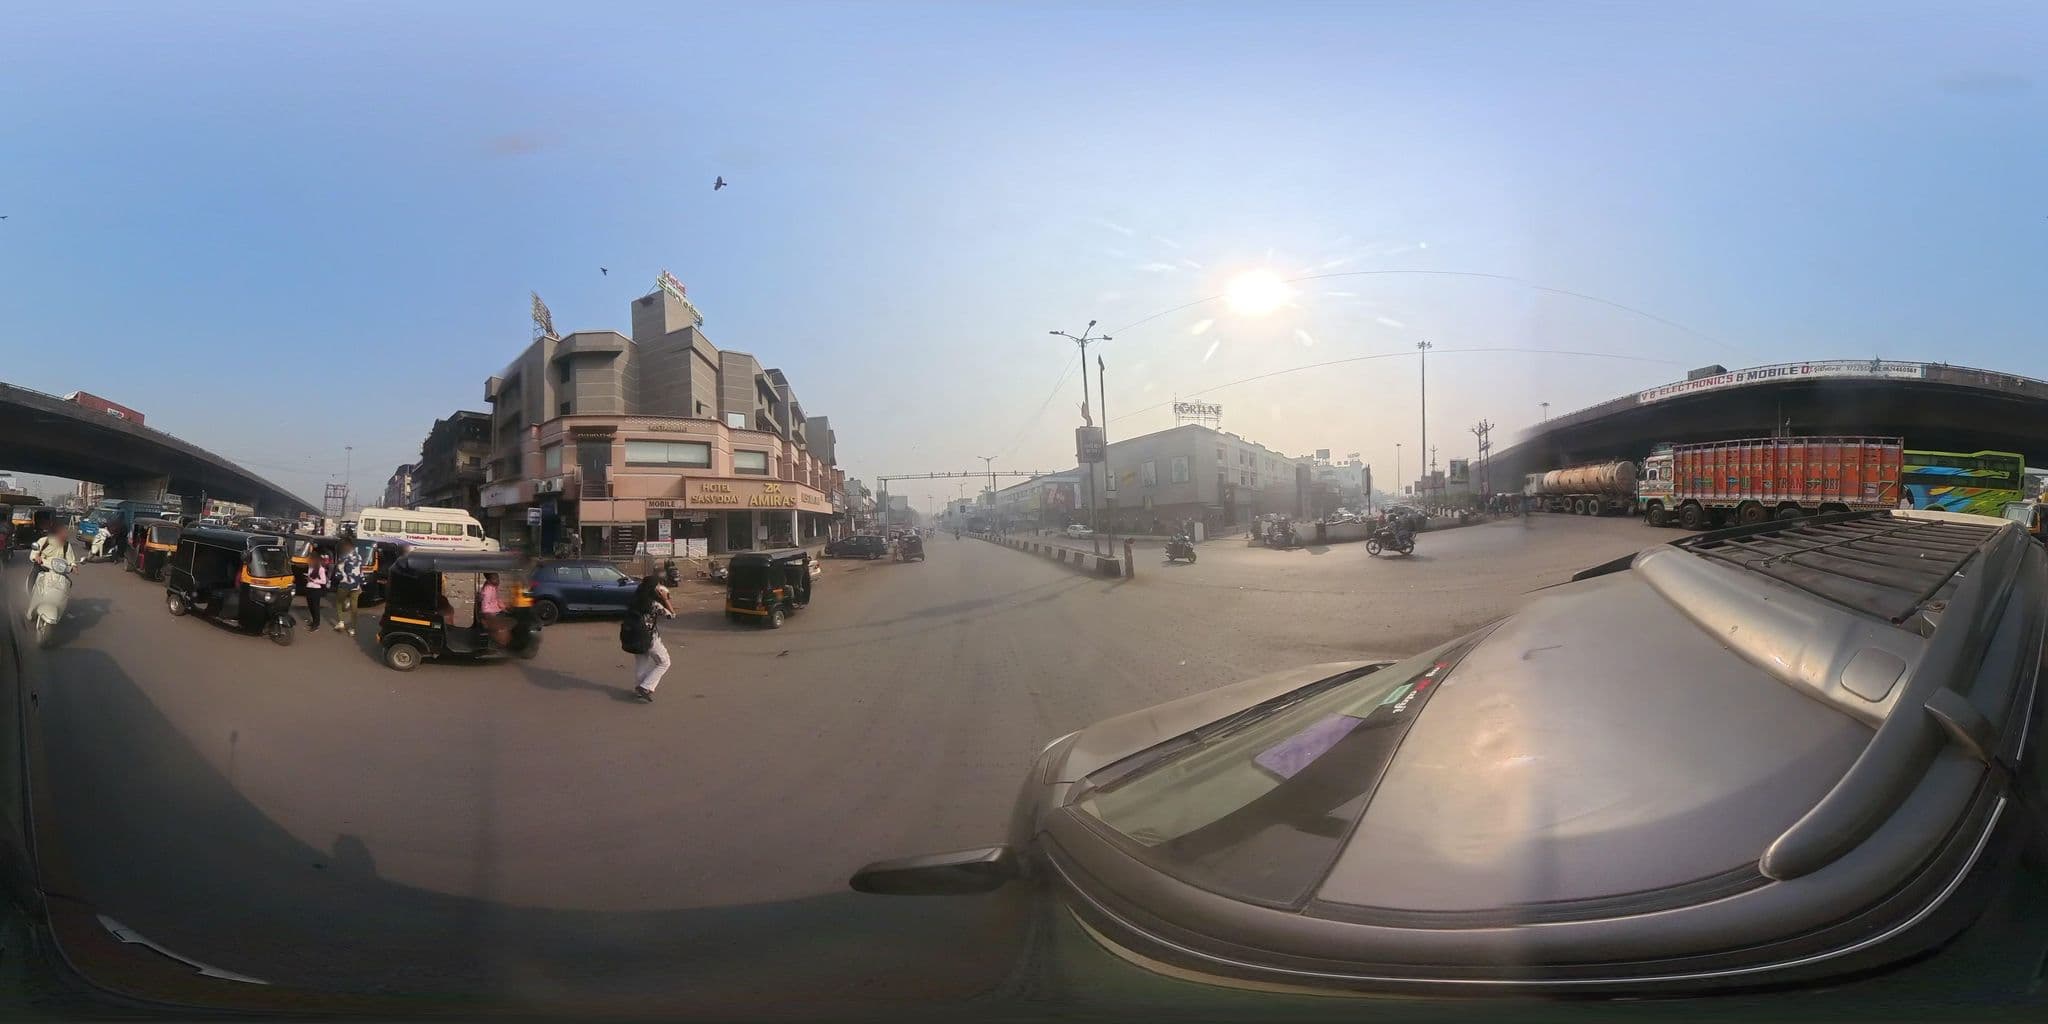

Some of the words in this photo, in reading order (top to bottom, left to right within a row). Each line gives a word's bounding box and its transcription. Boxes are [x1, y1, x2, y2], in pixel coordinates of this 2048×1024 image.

[1659, 374, 1733, 396] ELECTRONICS
[1746, 366, 1798, 380] MOBILE
[1174, 402, 1222, 414] FORTUNE
[702, 483, 731, 493] HOTEL
[649, 500, 675, 508] MOBILE
[749, 495, 796, 508] AMIRAS
